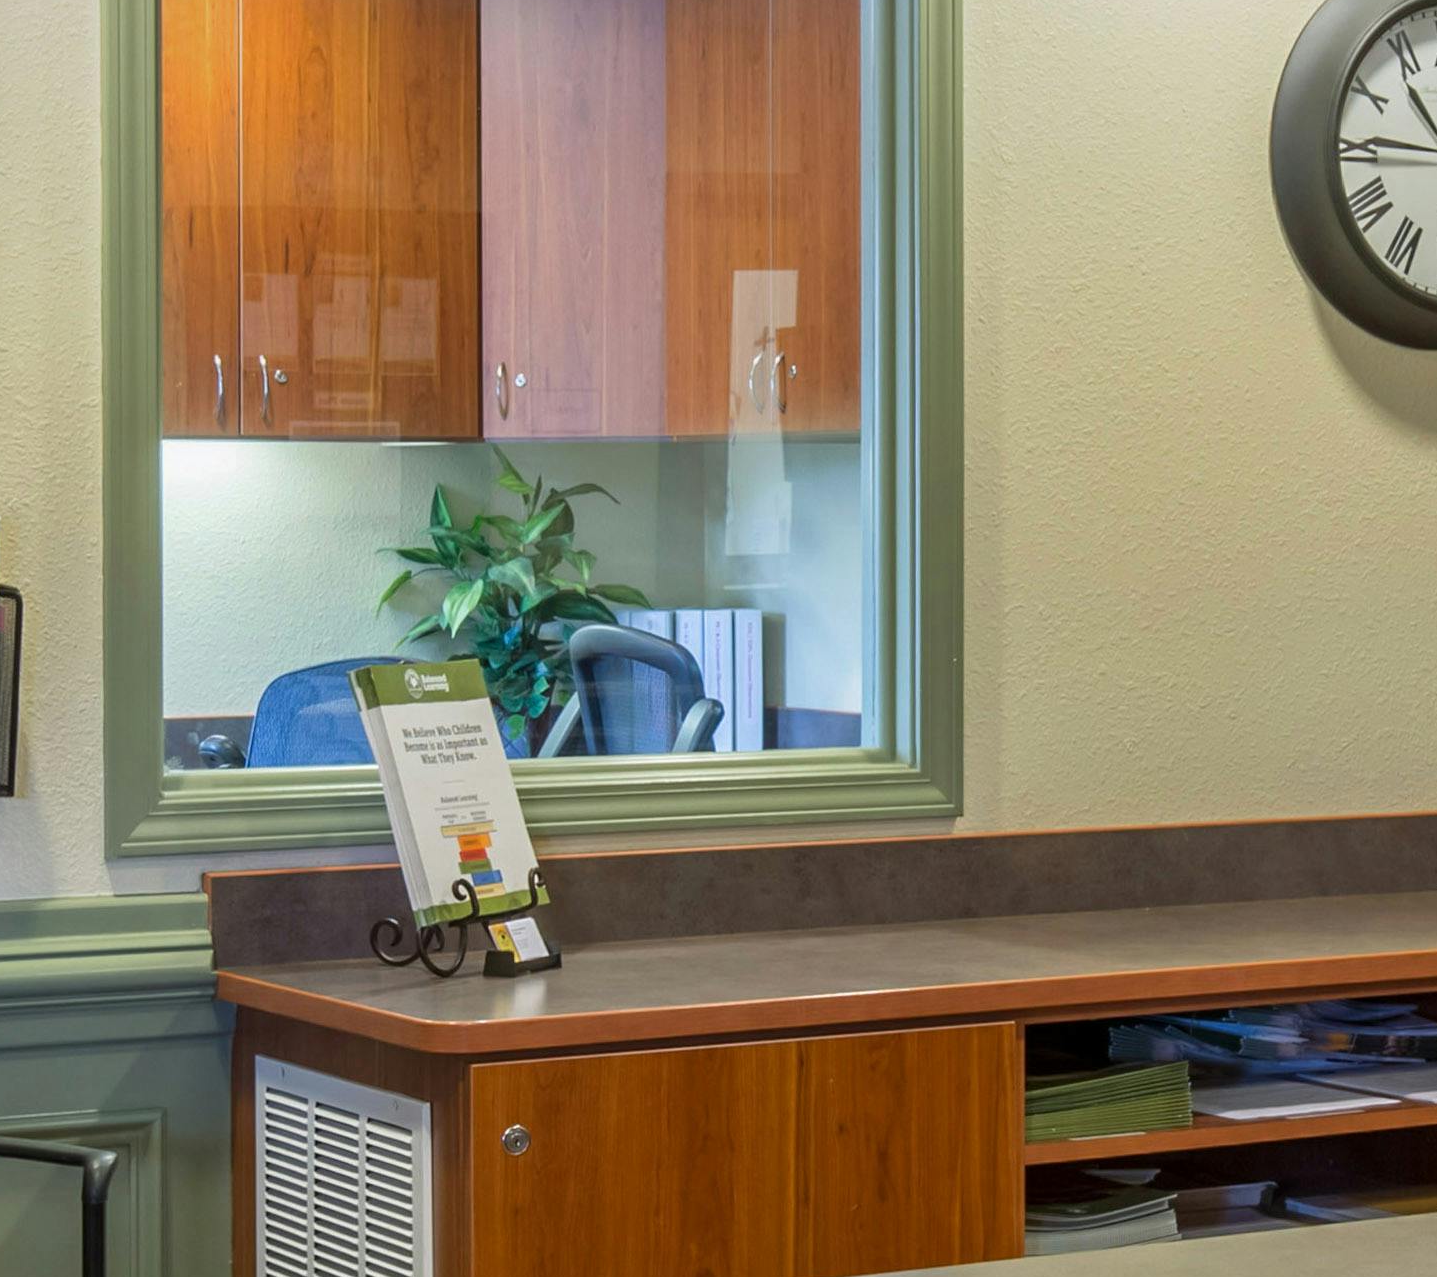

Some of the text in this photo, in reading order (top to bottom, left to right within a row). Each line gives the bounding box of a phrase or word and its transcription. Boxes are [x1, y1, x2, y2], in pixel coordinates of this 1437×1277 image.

[1386, 30, 1422, 76] XI
[1350, 75, 1389, 115] X
[1339, 137, 1378, 164] IX
[1348, 175, 1394, 234] VIII
[1384, 216, 1423, 275] VII
[402, 723, 482, 738] We Believe Who Children
[404, 741, 428, 753] Become
[443, 738, 479, 751] Important
[421, 751, 478, 765] What They Know.
